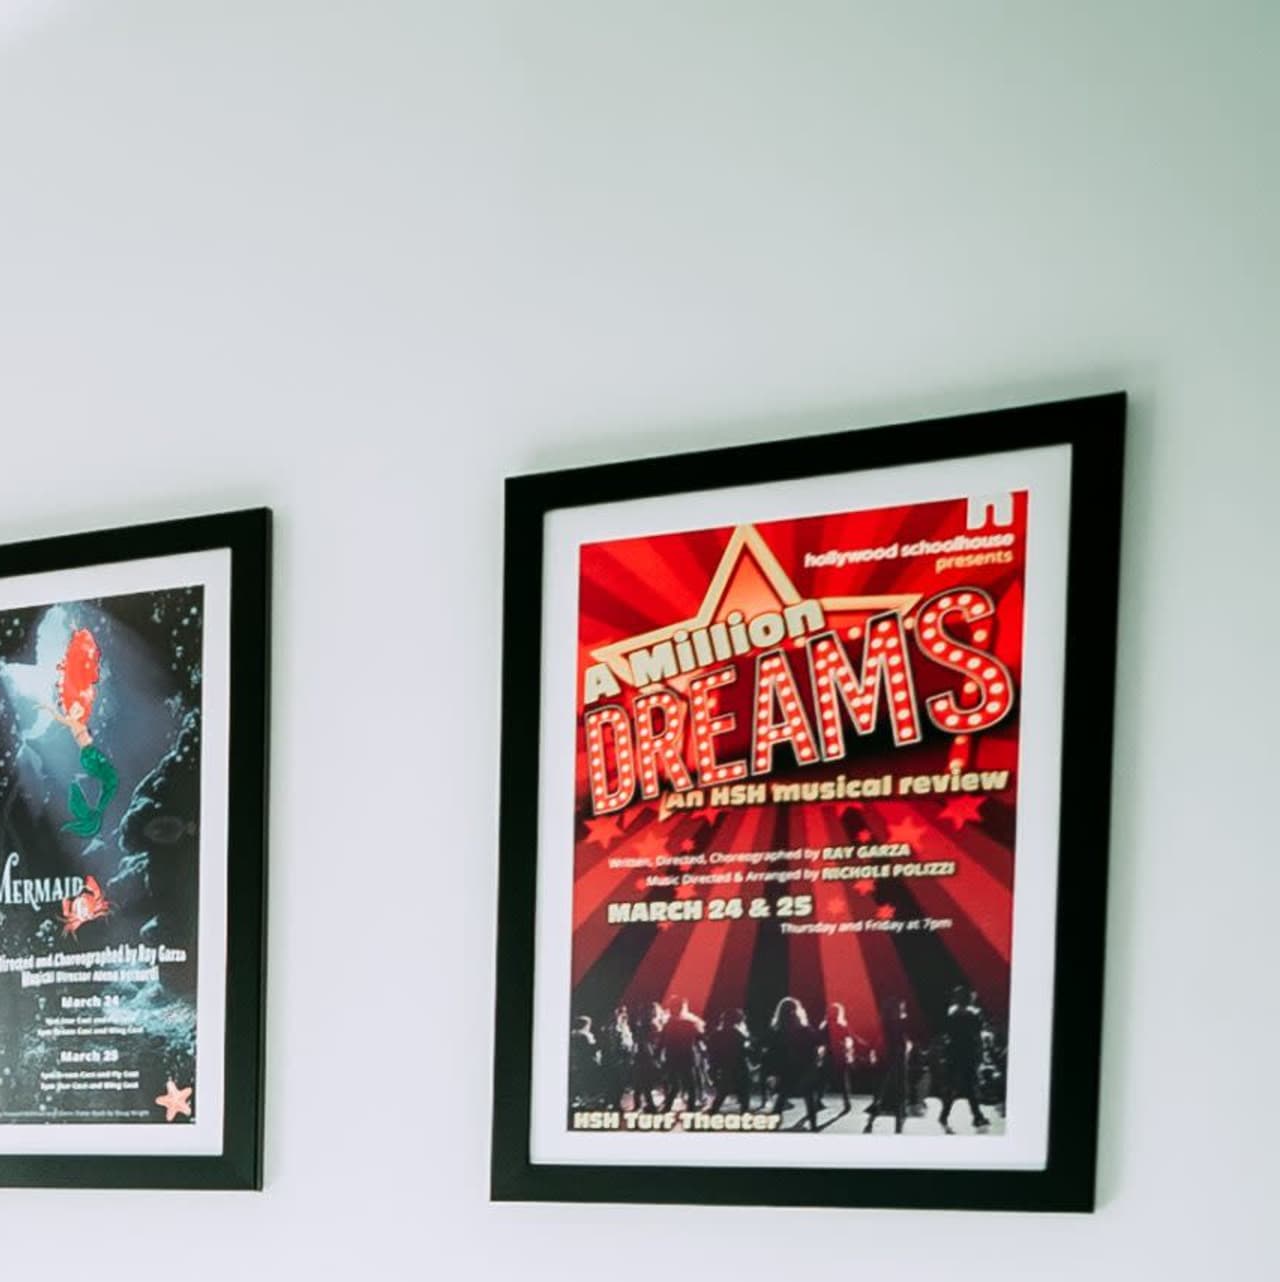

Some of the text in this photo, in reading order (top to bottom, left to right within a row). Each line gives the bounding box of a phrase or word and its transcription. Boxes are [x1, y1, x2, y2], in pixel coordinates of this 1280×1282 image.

[804, 533, 1015, 569] hollywood schoolhouse
[935, 550, 1013, 574] presents
[585, 599, 826, 704] A Million
[584, 586, 1014, 816] DREAMS
[711, 783, 766, 806] HSH
[771, 774, 893, 802] musical
[899, 766, 1009, 796] review
[656, 853, 707, 867] Directed,
[709, 848, 802, 864] Choreographed
[803, 849, 821, 861] by
[822, 846, 856, 860] RAY
[857, 843, 911, 859] GARZA
[682, 871, 732, 885] Directed
[745, 869, 801, 883] Arranged
[803, 869, 821, 881] by
[607, 895, 813, 924] MARCH 24 & 25
[780, 918, 953, 935] Thursday and Friday at 7pm
[35, 954, 53, 968] and
[61, 996, 101, 1008] March
[60, 1050, 101, 1062] March
[573, 1111, 781, 1130] HSH Turf Theater
